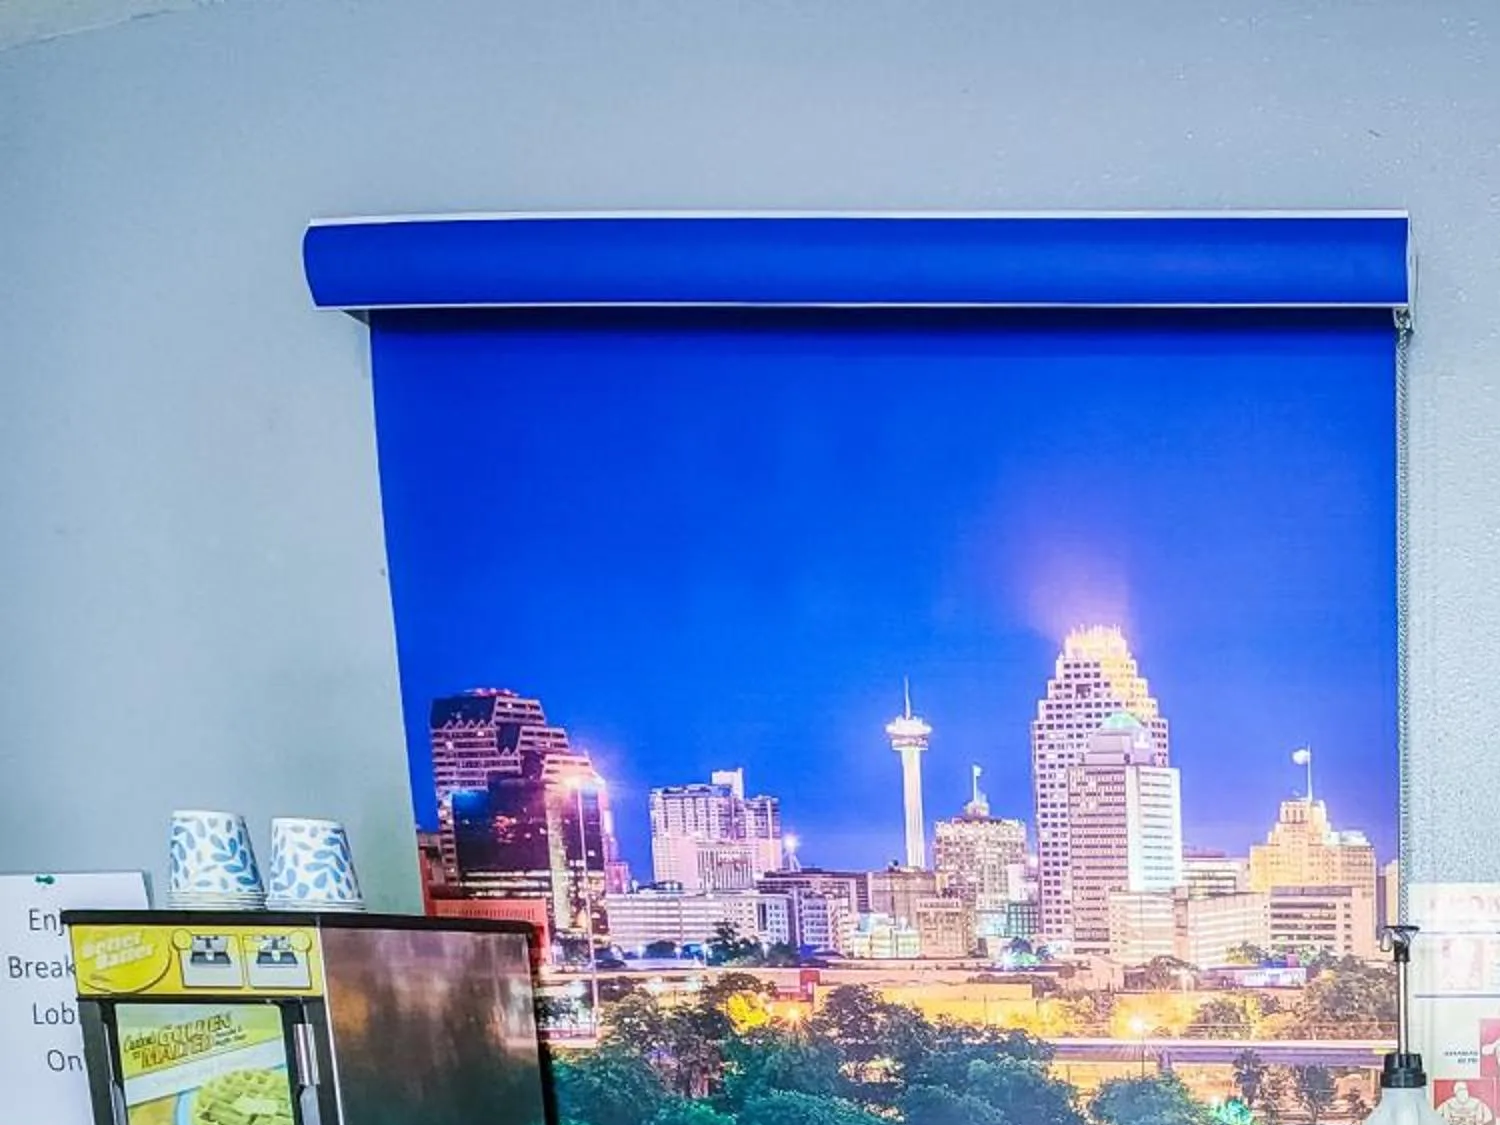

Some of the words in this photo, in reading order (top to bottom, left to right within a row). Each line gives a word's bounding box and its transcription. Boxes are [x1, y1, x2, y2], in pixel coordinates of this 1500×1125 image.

[8, 954, 76, 979] Break
[33, 1002, 75, 1025] Lob
[47, 1049, 83, 1072] On
